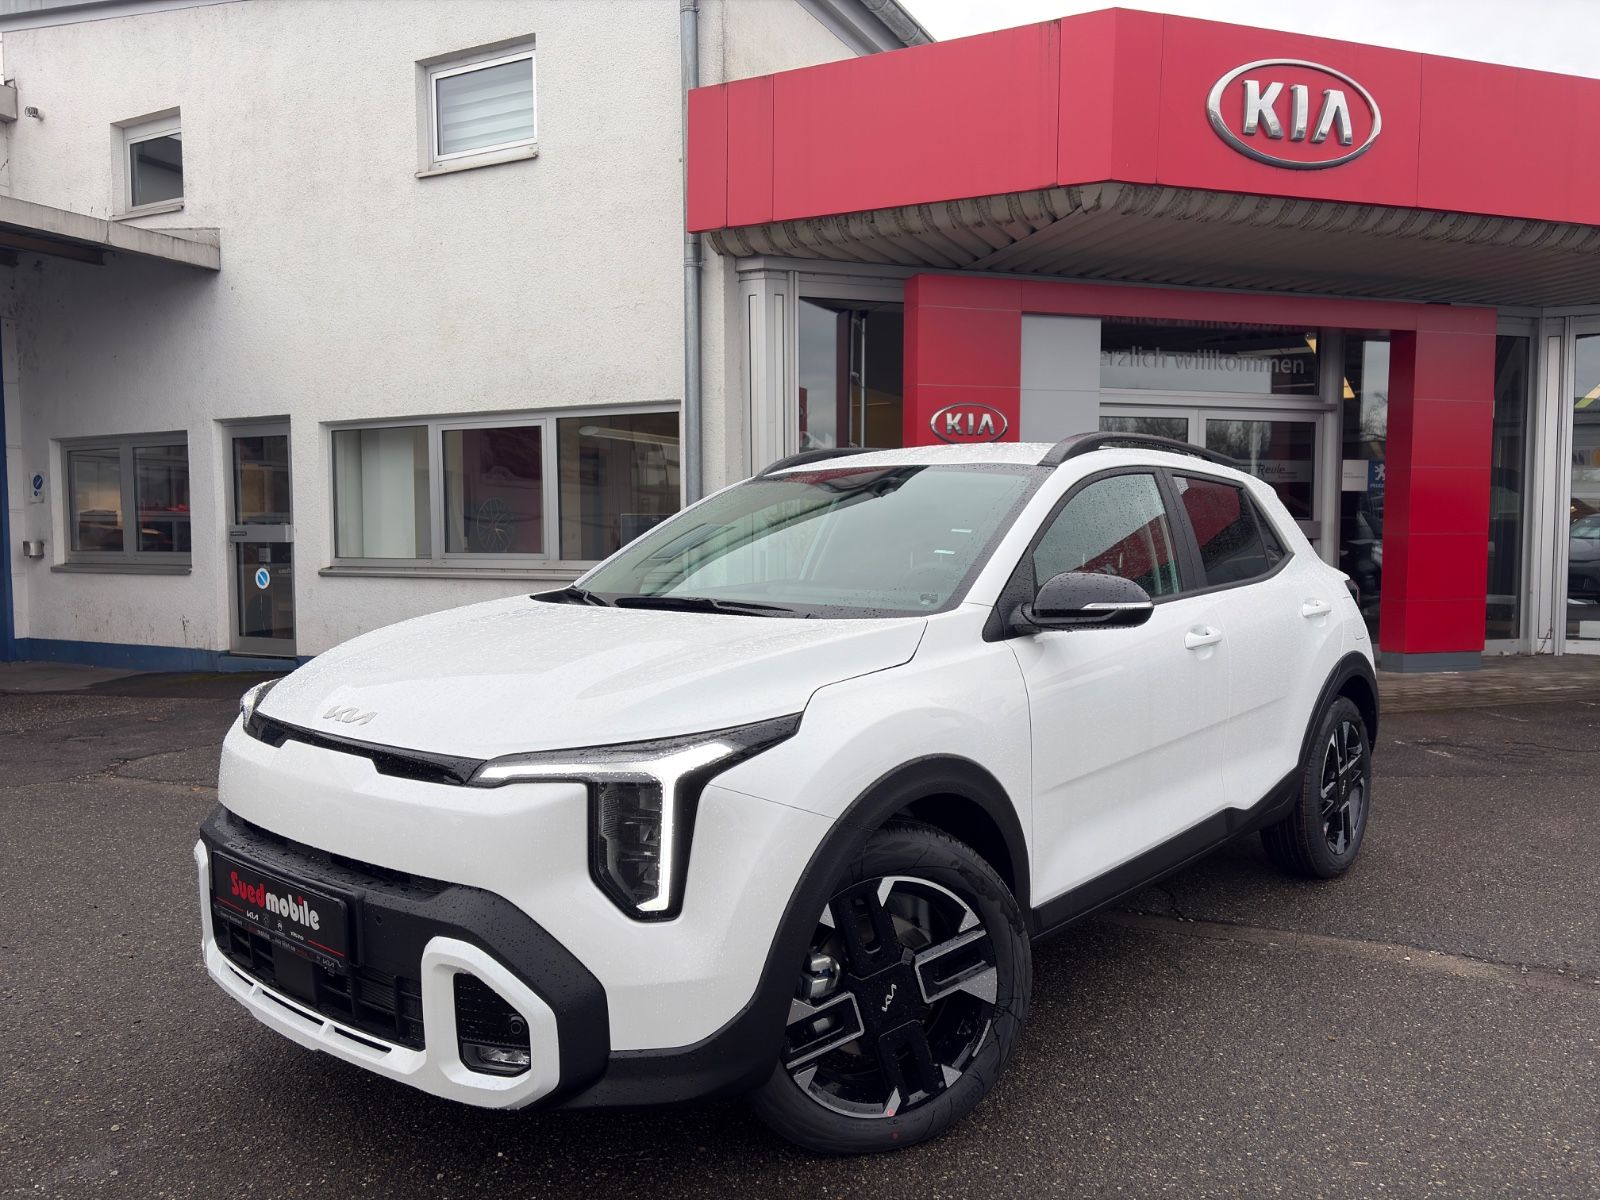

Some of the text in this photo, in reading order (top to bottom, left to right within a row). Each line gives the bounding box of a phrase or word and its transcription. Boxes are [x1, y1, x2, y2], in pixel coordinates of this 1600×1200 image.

[1242, 79, 1353, 145] KIA
[1100, 345, 1305, 374] erzlich willkommen
[946, 412, 995, 435] KIA
[230, 871, 320, 931] Suedmobile
